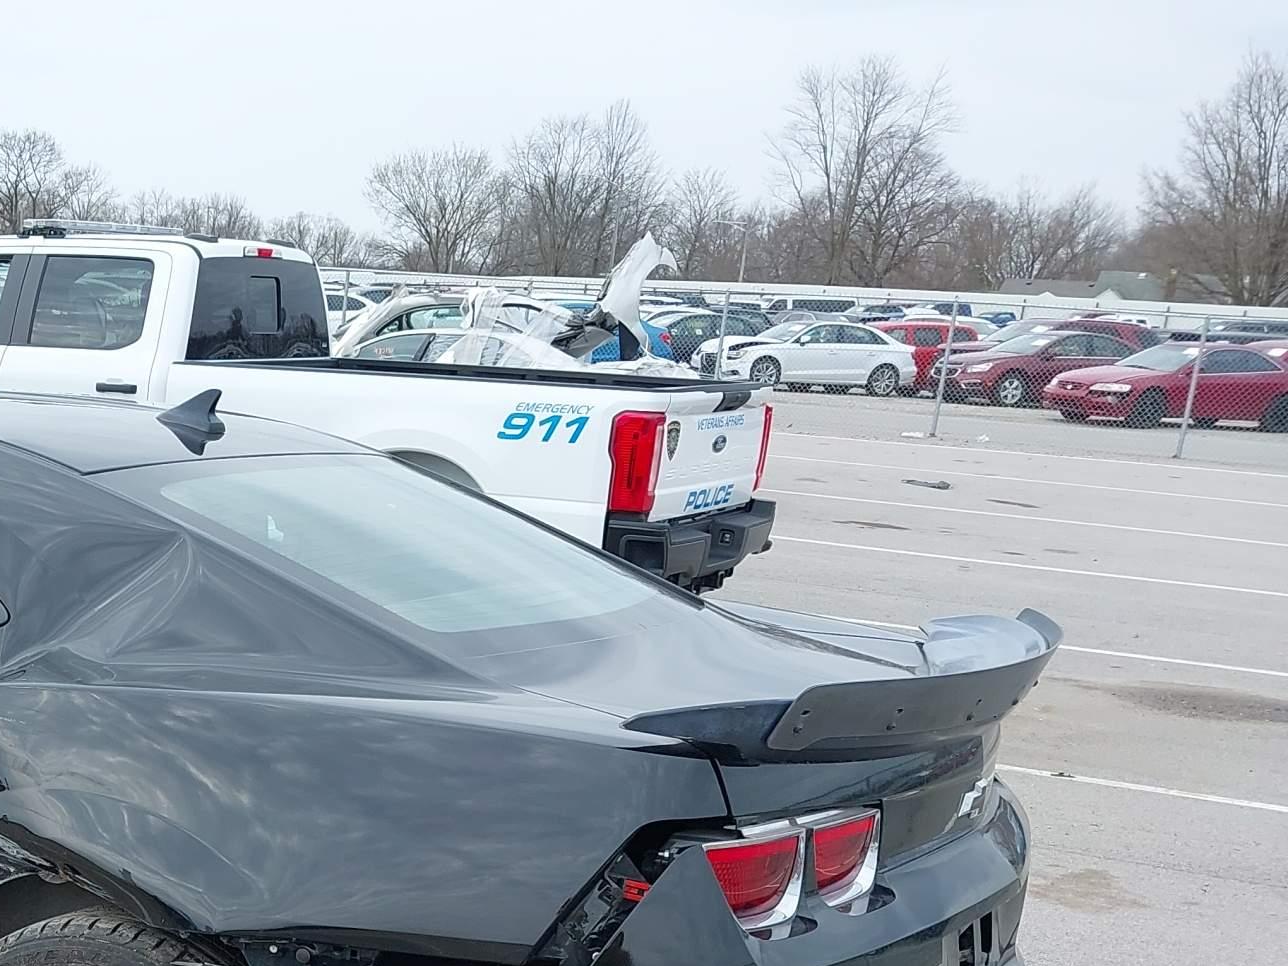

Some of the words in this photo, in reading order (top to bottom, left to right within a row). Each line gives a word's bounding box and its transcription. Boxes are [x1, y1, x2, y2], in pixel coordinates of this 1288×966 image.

[515, 401, 594, 415] EMERGENCY
[496, 412, 590, 443] 911
[683, 484, 734, 512] POLICE
